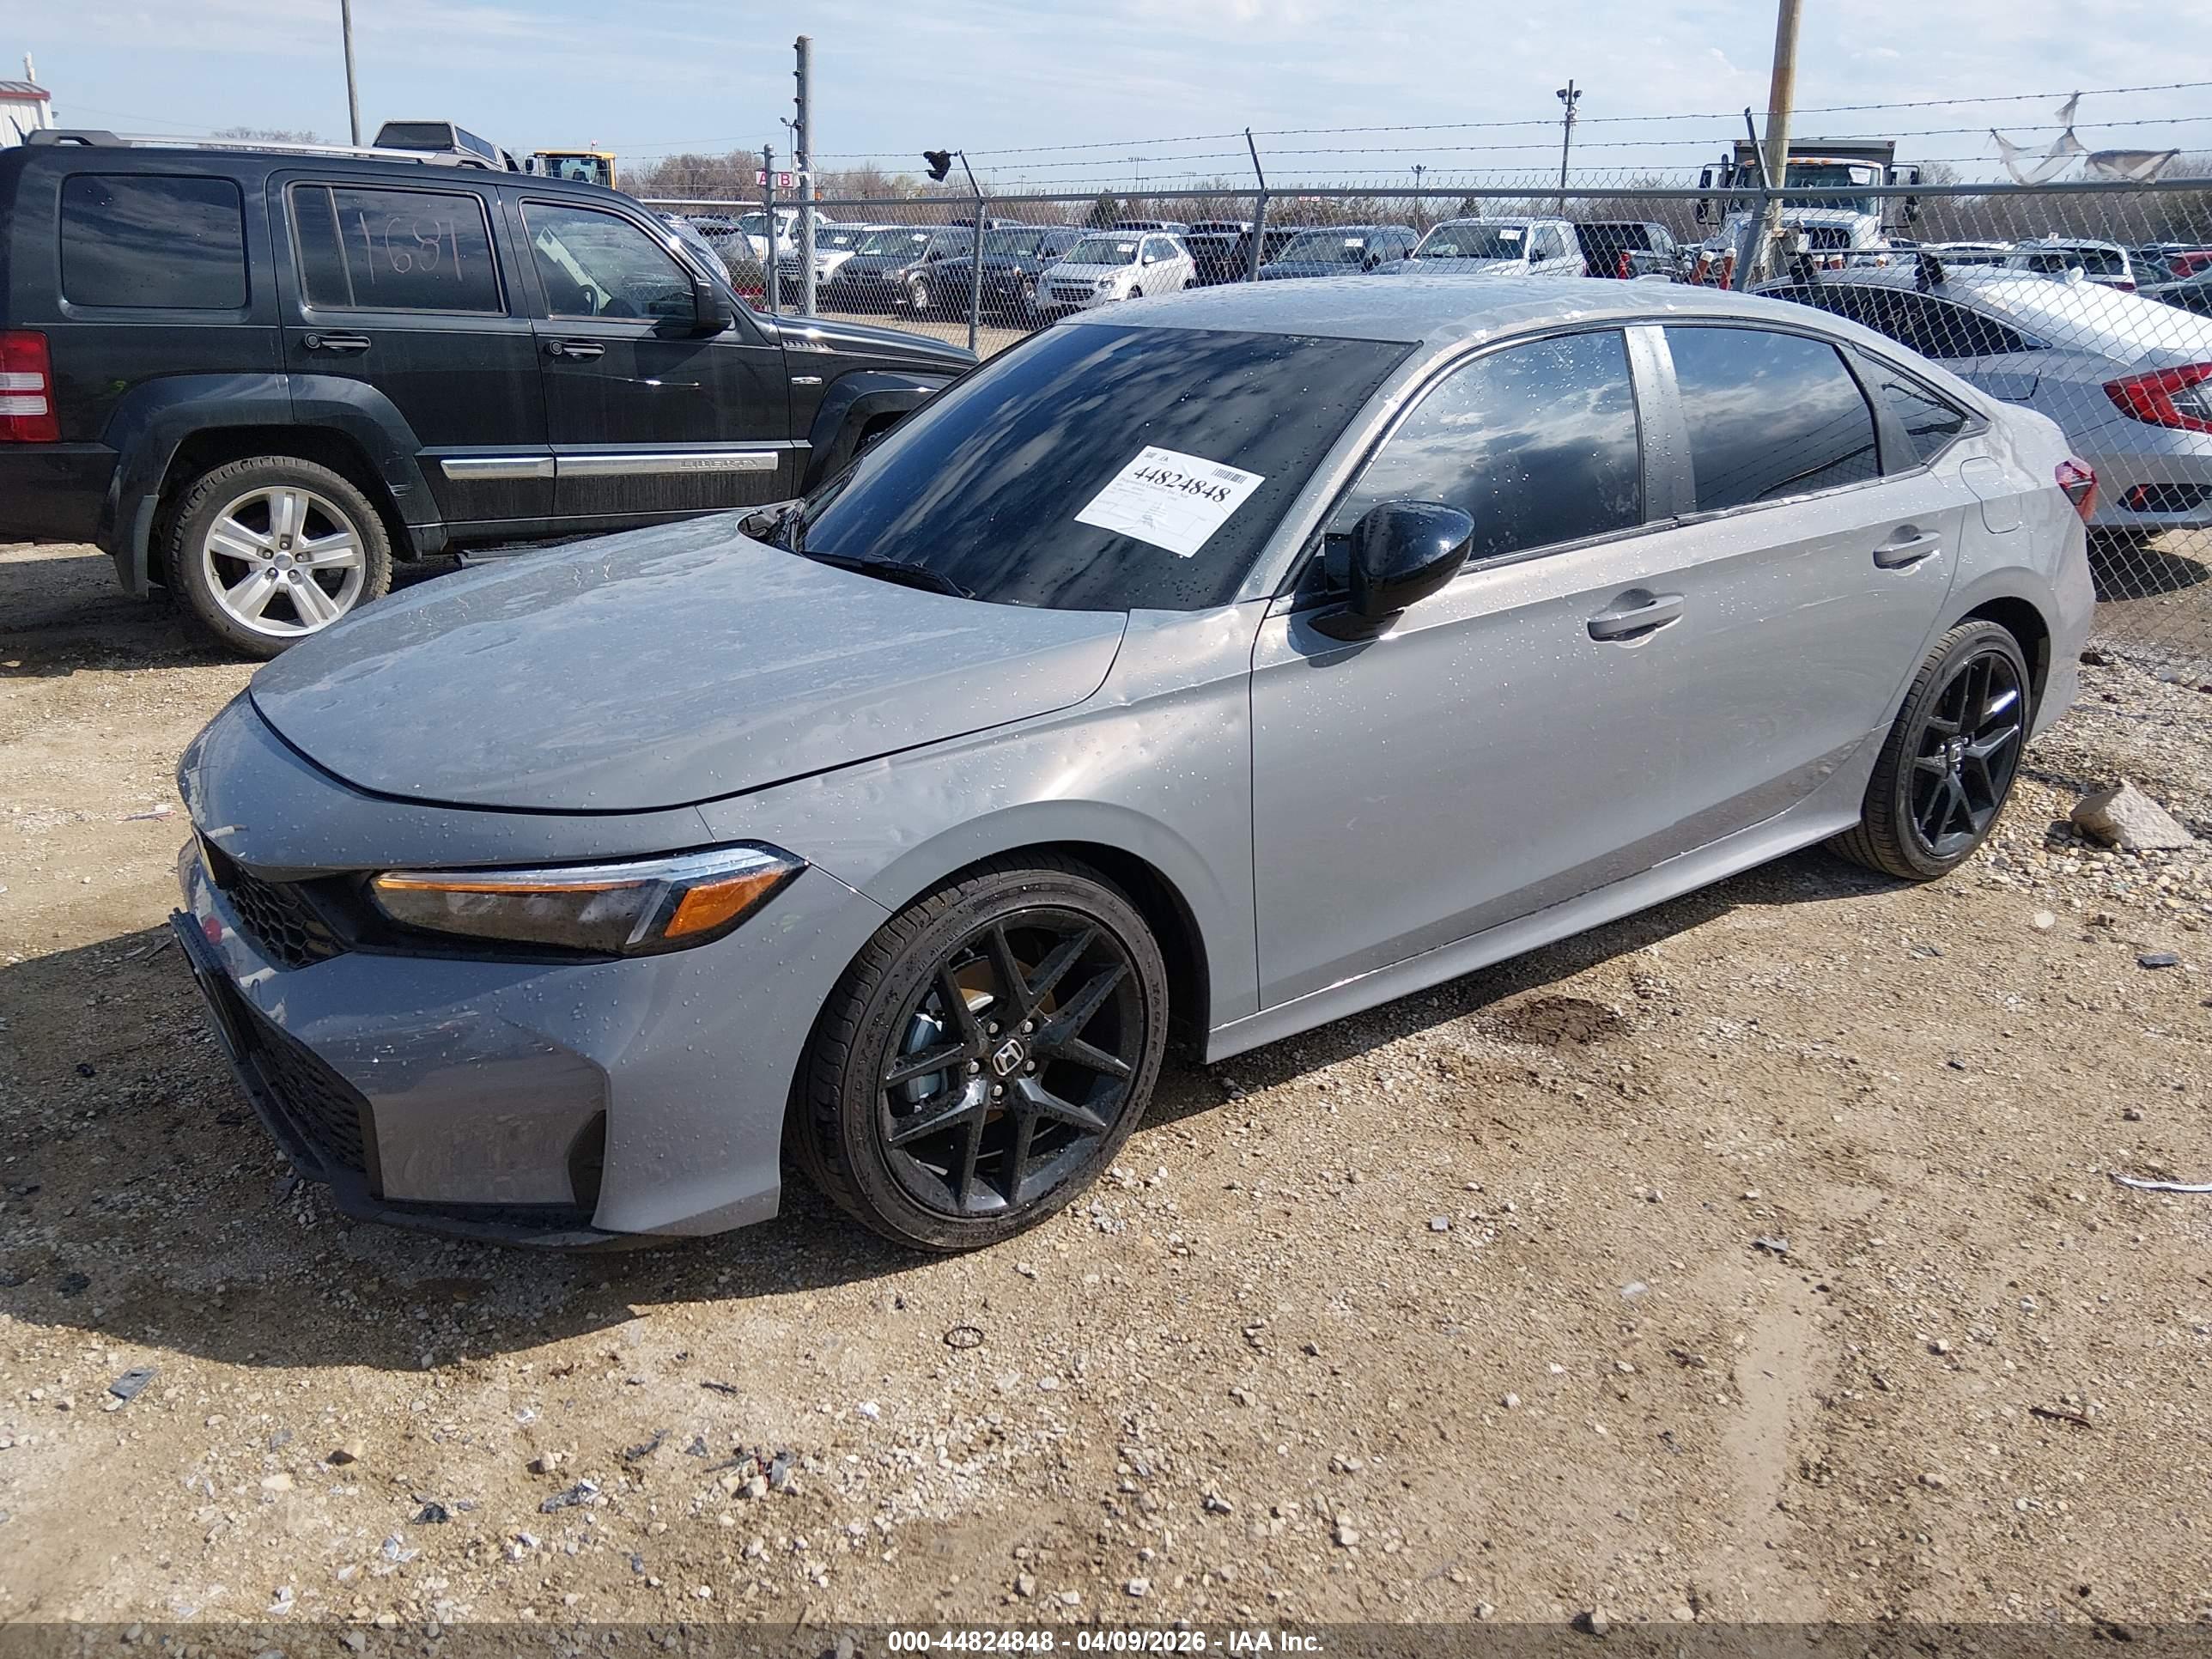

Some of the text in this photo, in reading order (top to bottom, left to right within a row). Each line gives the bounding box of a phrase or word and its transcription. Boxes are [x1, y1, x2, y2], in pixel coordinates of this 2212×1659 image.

[781, 174, 791, 185] B
[680, 459, 758, 469] LIBERTY
[1133, 465, 1231, 502] 44824848
